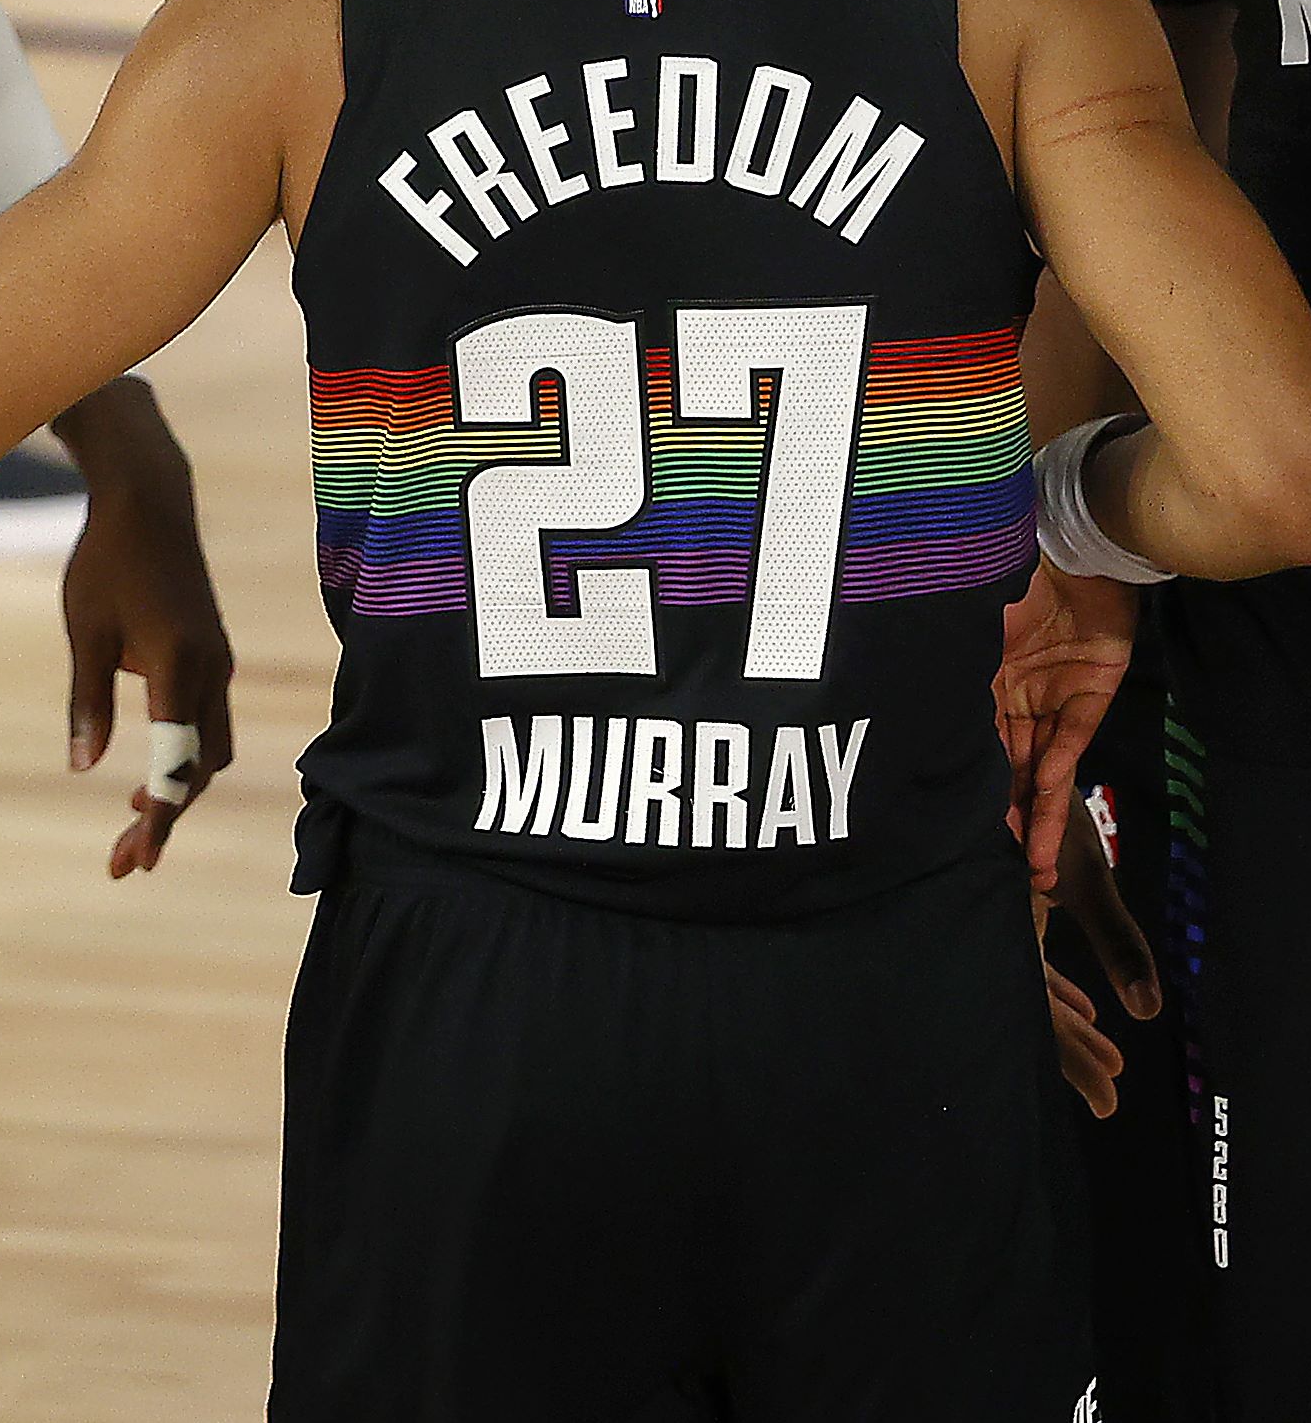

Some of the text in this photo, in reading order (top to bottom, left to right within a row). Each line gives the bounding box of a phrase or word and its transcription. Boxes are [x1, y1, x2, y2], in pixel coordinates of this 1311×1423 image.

[378, 56, 925, 267] FREEDOM
[454, 305, 868, 680] 27
[474, 714, 871, 849] MURRAY
[1213, 1095, 1229, 1268] 5280
